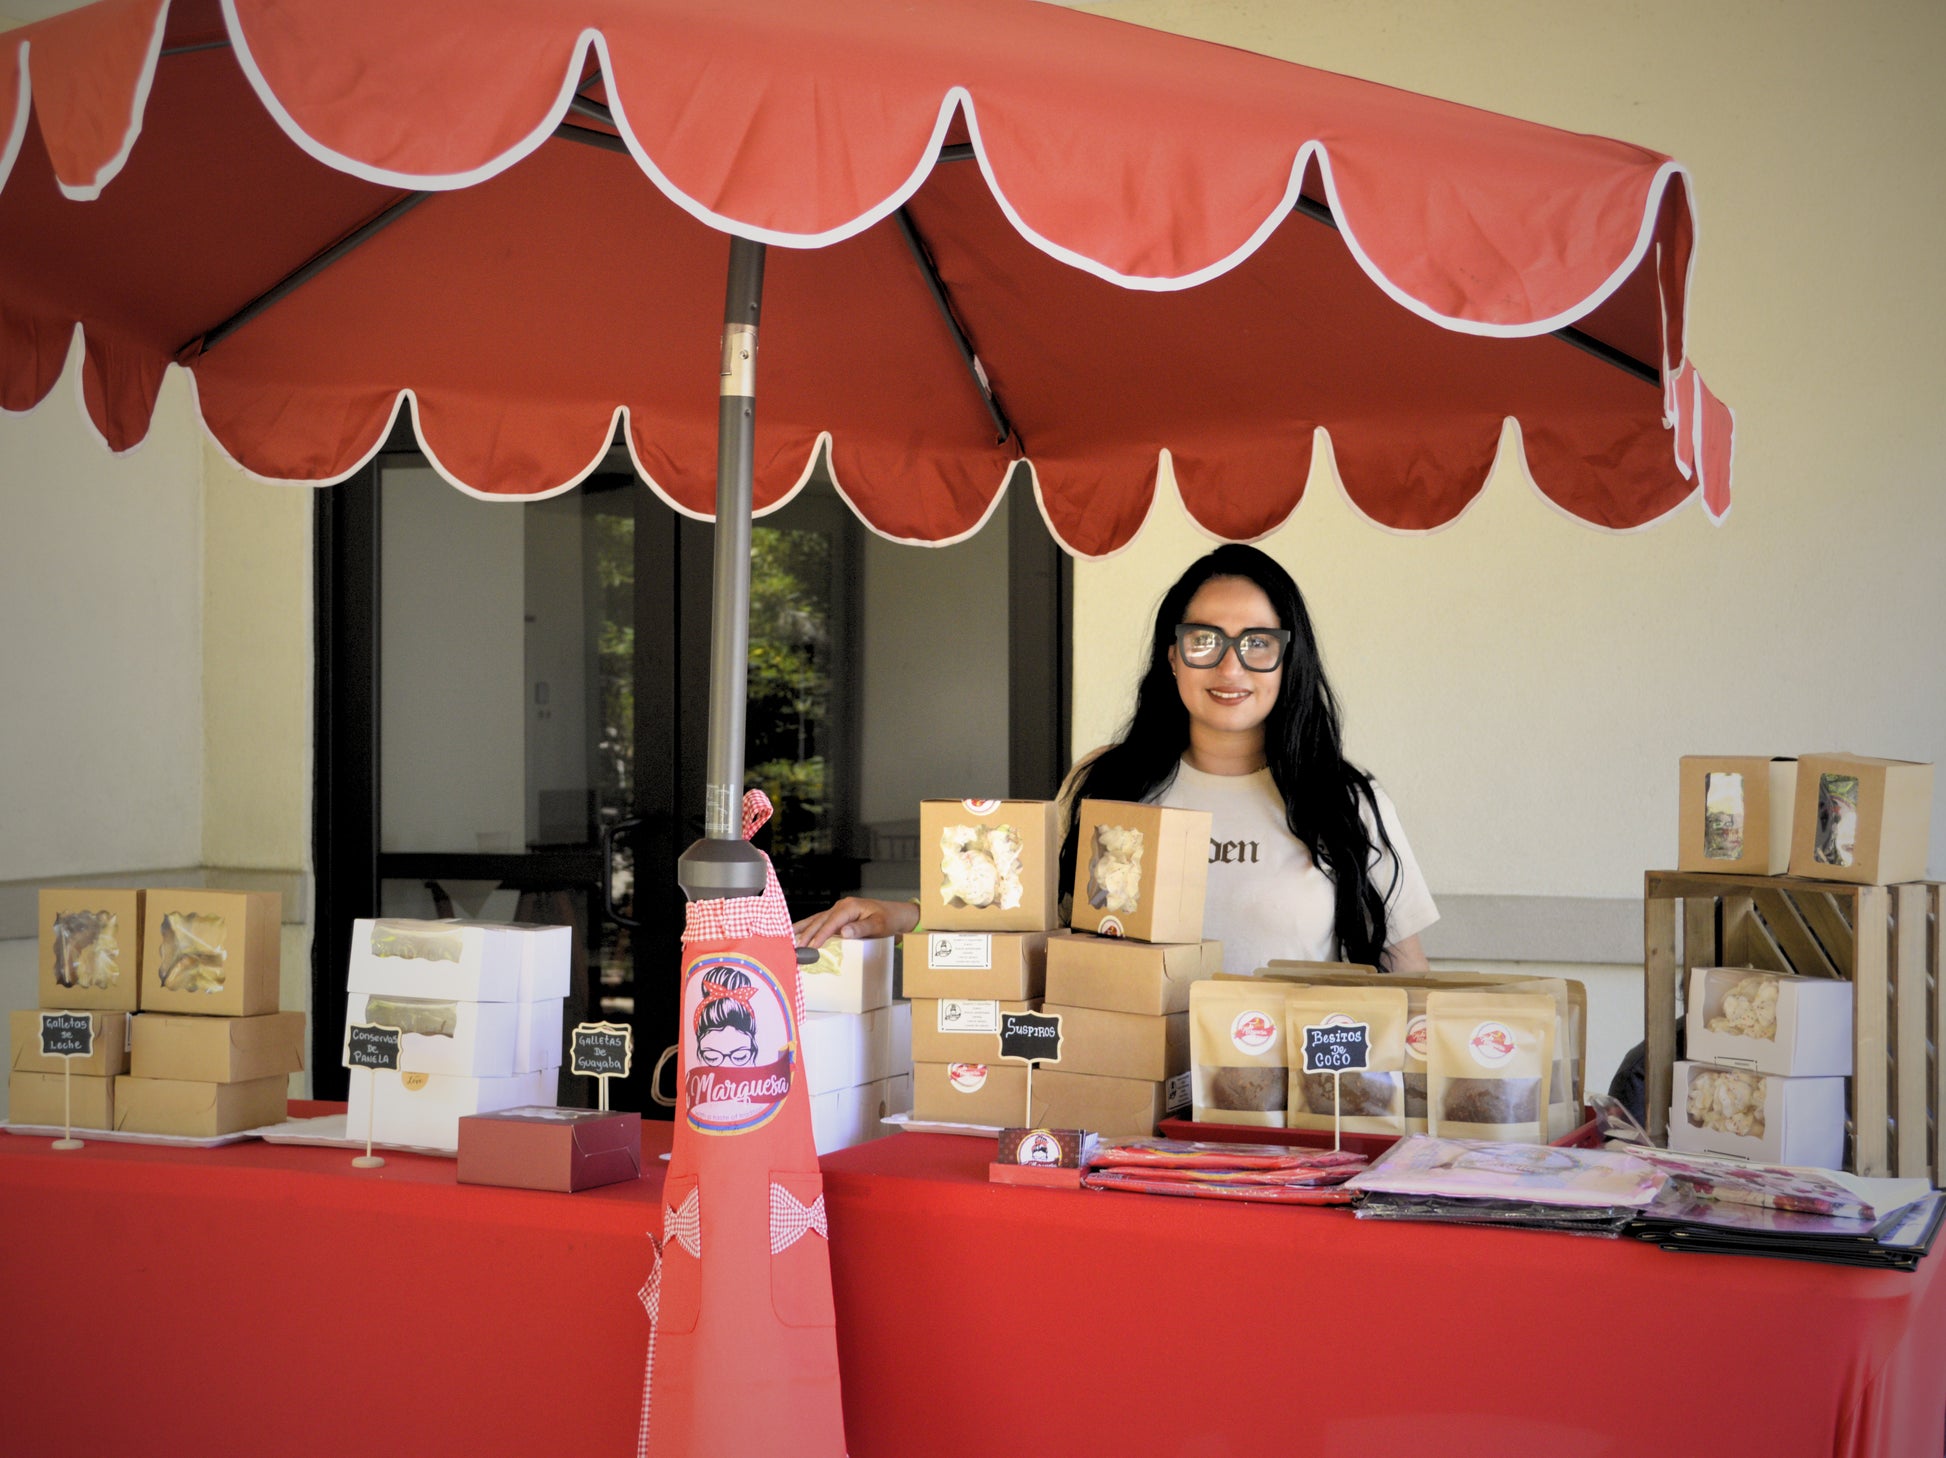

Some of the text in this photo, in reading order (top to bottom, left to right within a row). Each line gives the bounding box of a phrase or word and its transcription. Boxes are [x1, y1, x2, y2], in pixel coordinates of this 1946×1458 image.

[352, 1028, 398, 1044] Conservas
[50, 1040, 82, 1049] Leche
[578, 1056, 621, 1071] Guayaba
[690, 1072, 789, 1104] Marquesa
